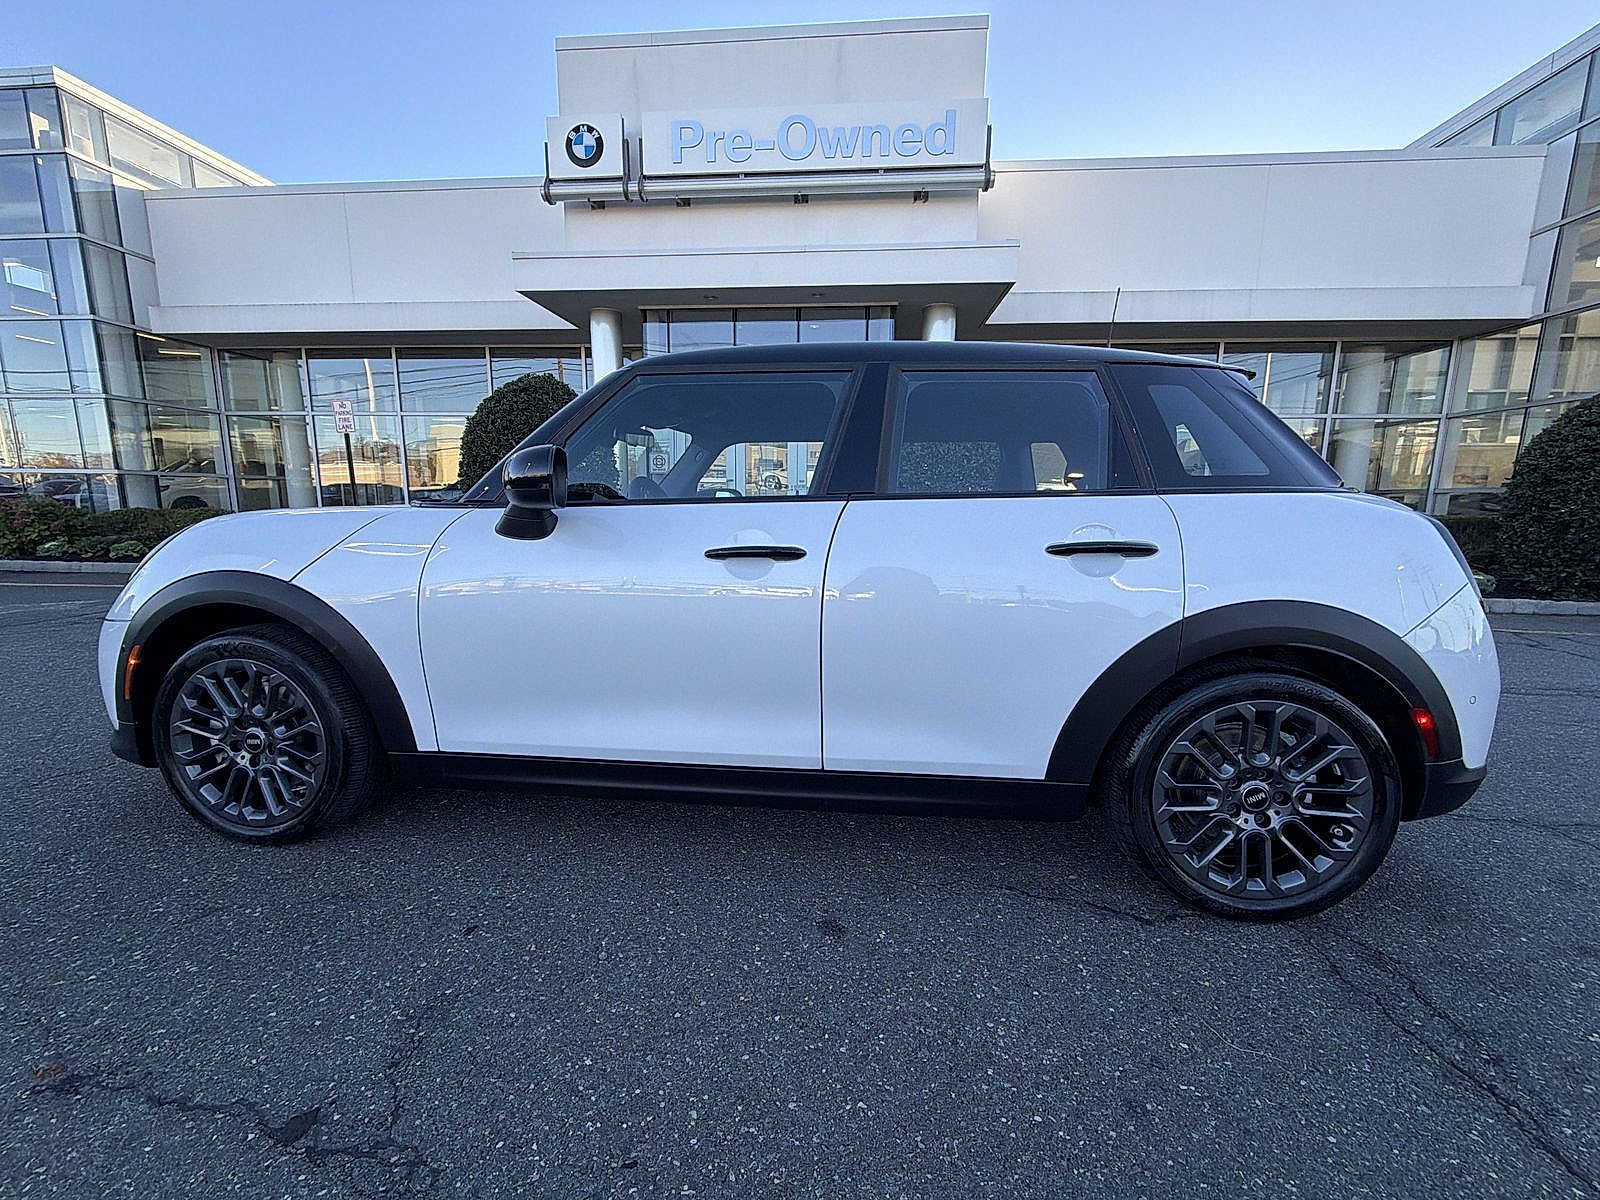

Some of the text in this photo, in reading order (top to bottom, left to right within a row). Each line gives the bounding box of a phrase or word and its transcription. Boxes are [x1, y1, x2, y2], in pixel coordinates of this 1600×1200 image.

[568, 125, 600, 139] BMW
[671, 110, 956, 164] Pre-Owned
[1246, 791, 1266, 804] MINI
